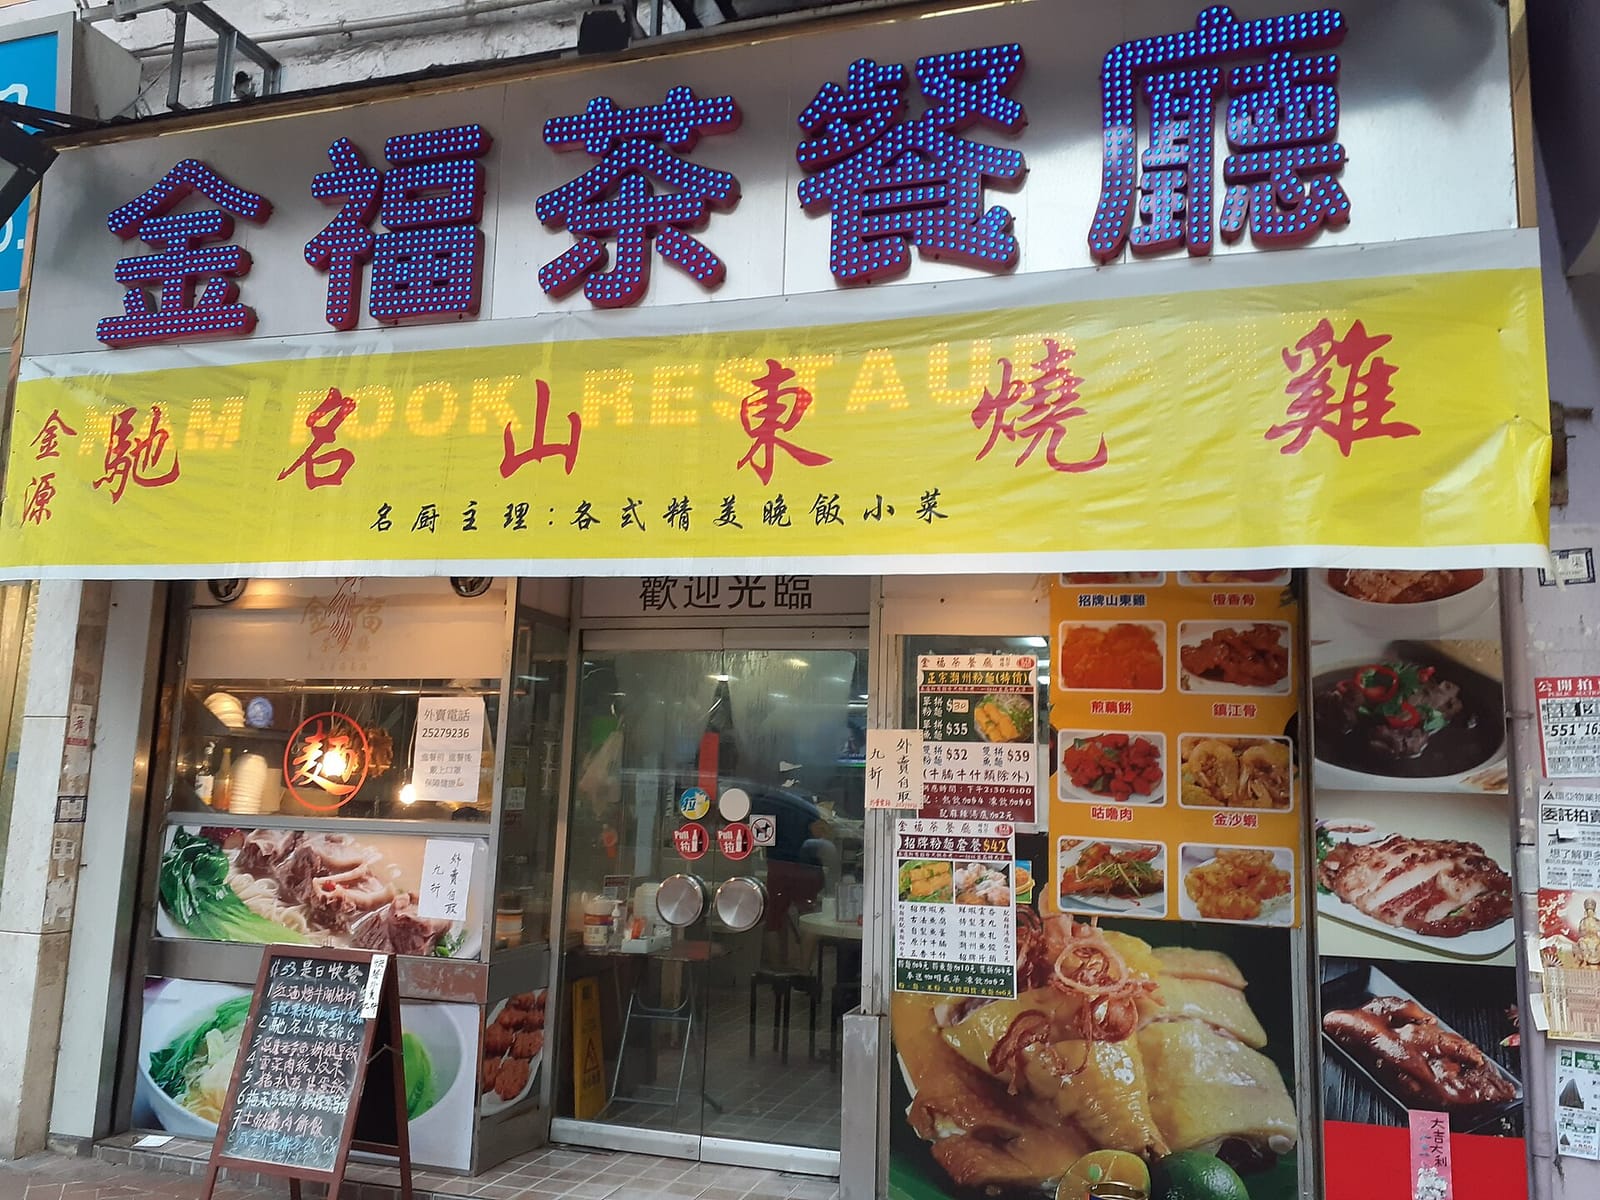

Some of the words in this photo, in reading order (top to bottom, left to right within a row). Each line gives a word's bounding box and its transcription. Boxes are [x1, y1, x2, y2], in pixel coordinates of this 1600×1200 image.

[97, 5, 1348, 347] 金福茶餐廳
[93, 318, 1421, 504] 馳名山東燒雞
[20, 408, 77, 528] 金源
[638, 575, 813, 611] 歡迎光臨
[1538, 679, 1600, 692] 公開拍
[421, 727, 470, 738] 25279236
[946, 722, 968, 735] $35
[946, 748, 968, 761] $32
[1007, 749, 1030, 762] $39
[1091, 807, 1133, 821] 咕嚕肉
[1213, 813, 1258, 828] 金沙蝦
[674, 830, 689, 840] Pull
[717, 830, 733, 840] Pull
[983, 838, 1006, 853] $42
[1429, 1117, 1448, 1167] 大吉大利
